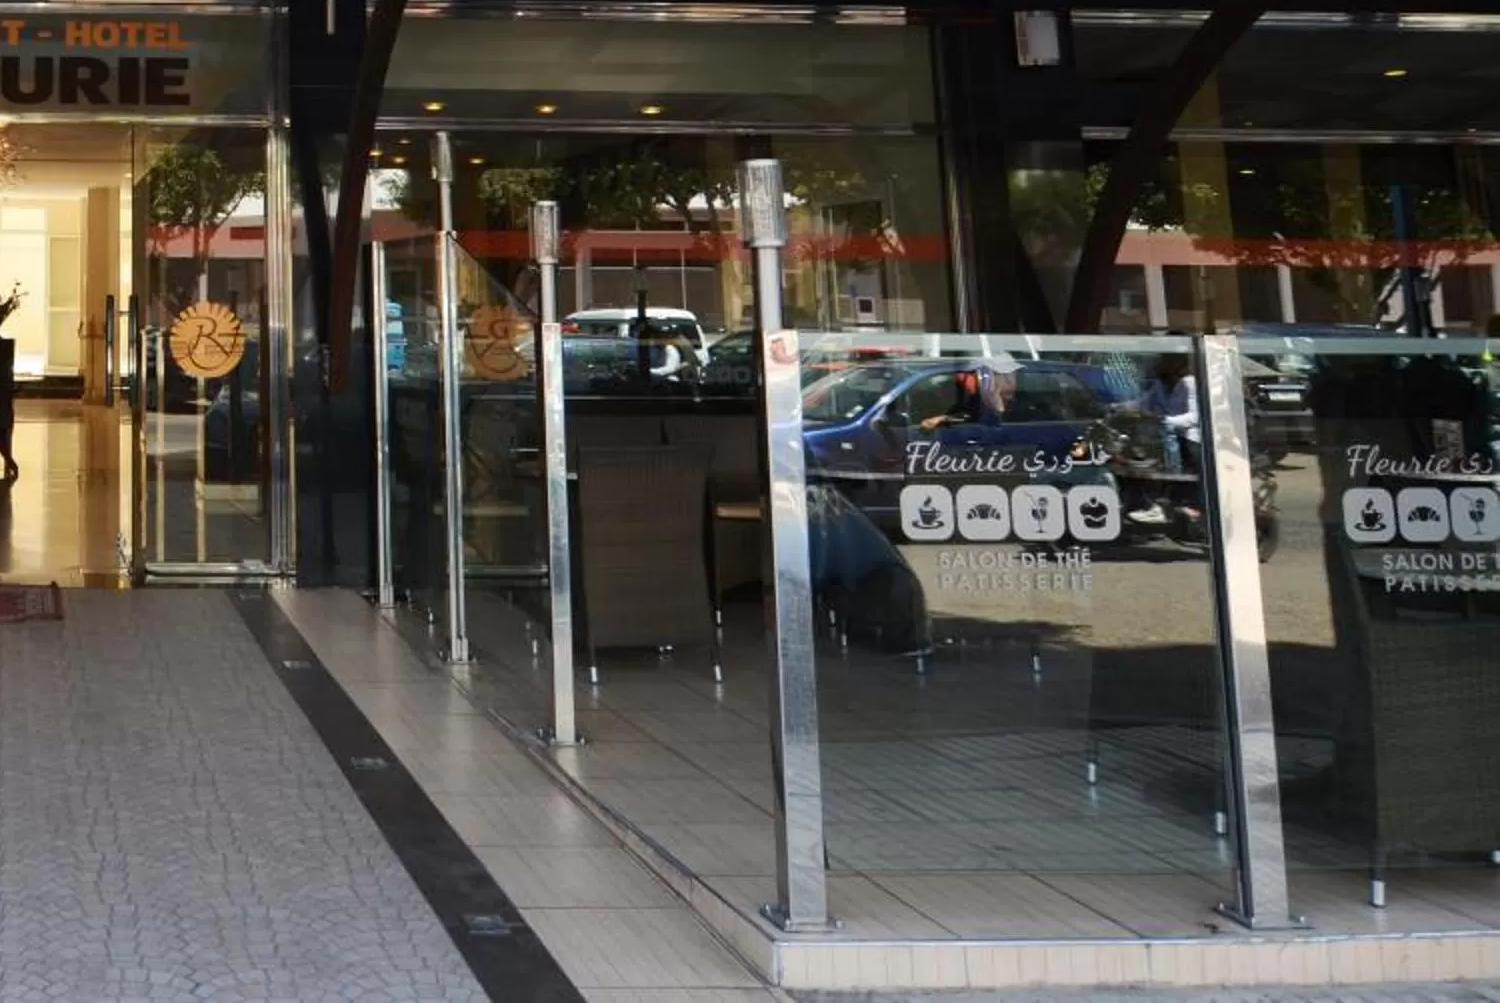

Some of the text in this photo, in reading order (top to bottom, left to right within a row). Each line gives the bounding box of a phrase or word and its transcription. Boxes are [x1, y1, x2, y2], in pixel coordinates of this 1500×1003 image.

[65, 21, 190, 50] HOTEL
[905, 440, 1016, 475] Fleurie
[1347, 444, 1451, 477] Fleurie
[940, 552, 1013, 570] SALON
[1021, 552, 1047, 569] DE
[1382, 553, 1453, 570] SALON
[1461, 553, 1487, 570] DE
[939, 573, 1092, 591] PATISSERIE
